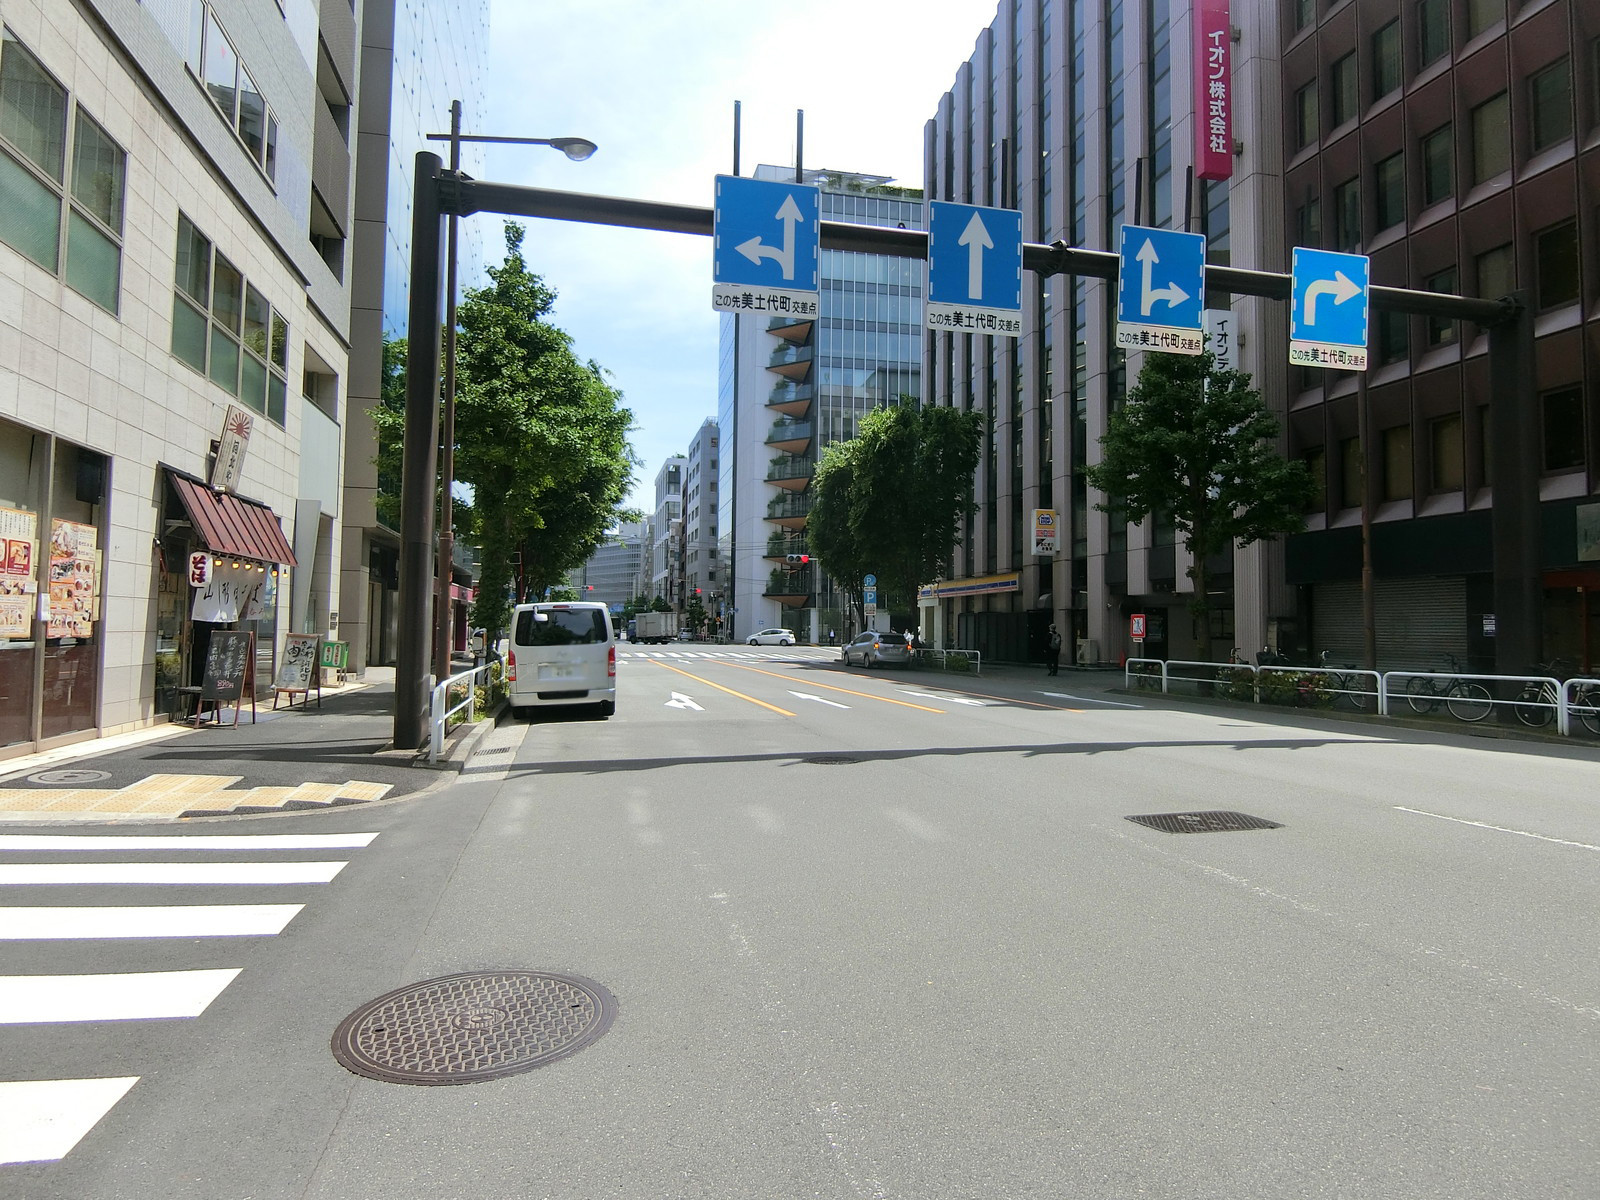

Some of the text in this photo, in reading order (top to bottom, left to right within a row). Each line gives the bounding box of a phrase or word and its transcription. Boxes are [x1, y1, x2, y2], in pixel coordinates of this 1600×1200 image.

[1208, 30, 1227, 153] イオン株式会社
[715, 291, 817, 315] この先美土代町交差点
[929, 310, 1021, 333] この先美土代町交差点
[1118, 329, 1201, 351] この先美土代町交差点
[1291, 347, 1366, 367] この先美土代町交差点
[867, 592, 874, 602] P
